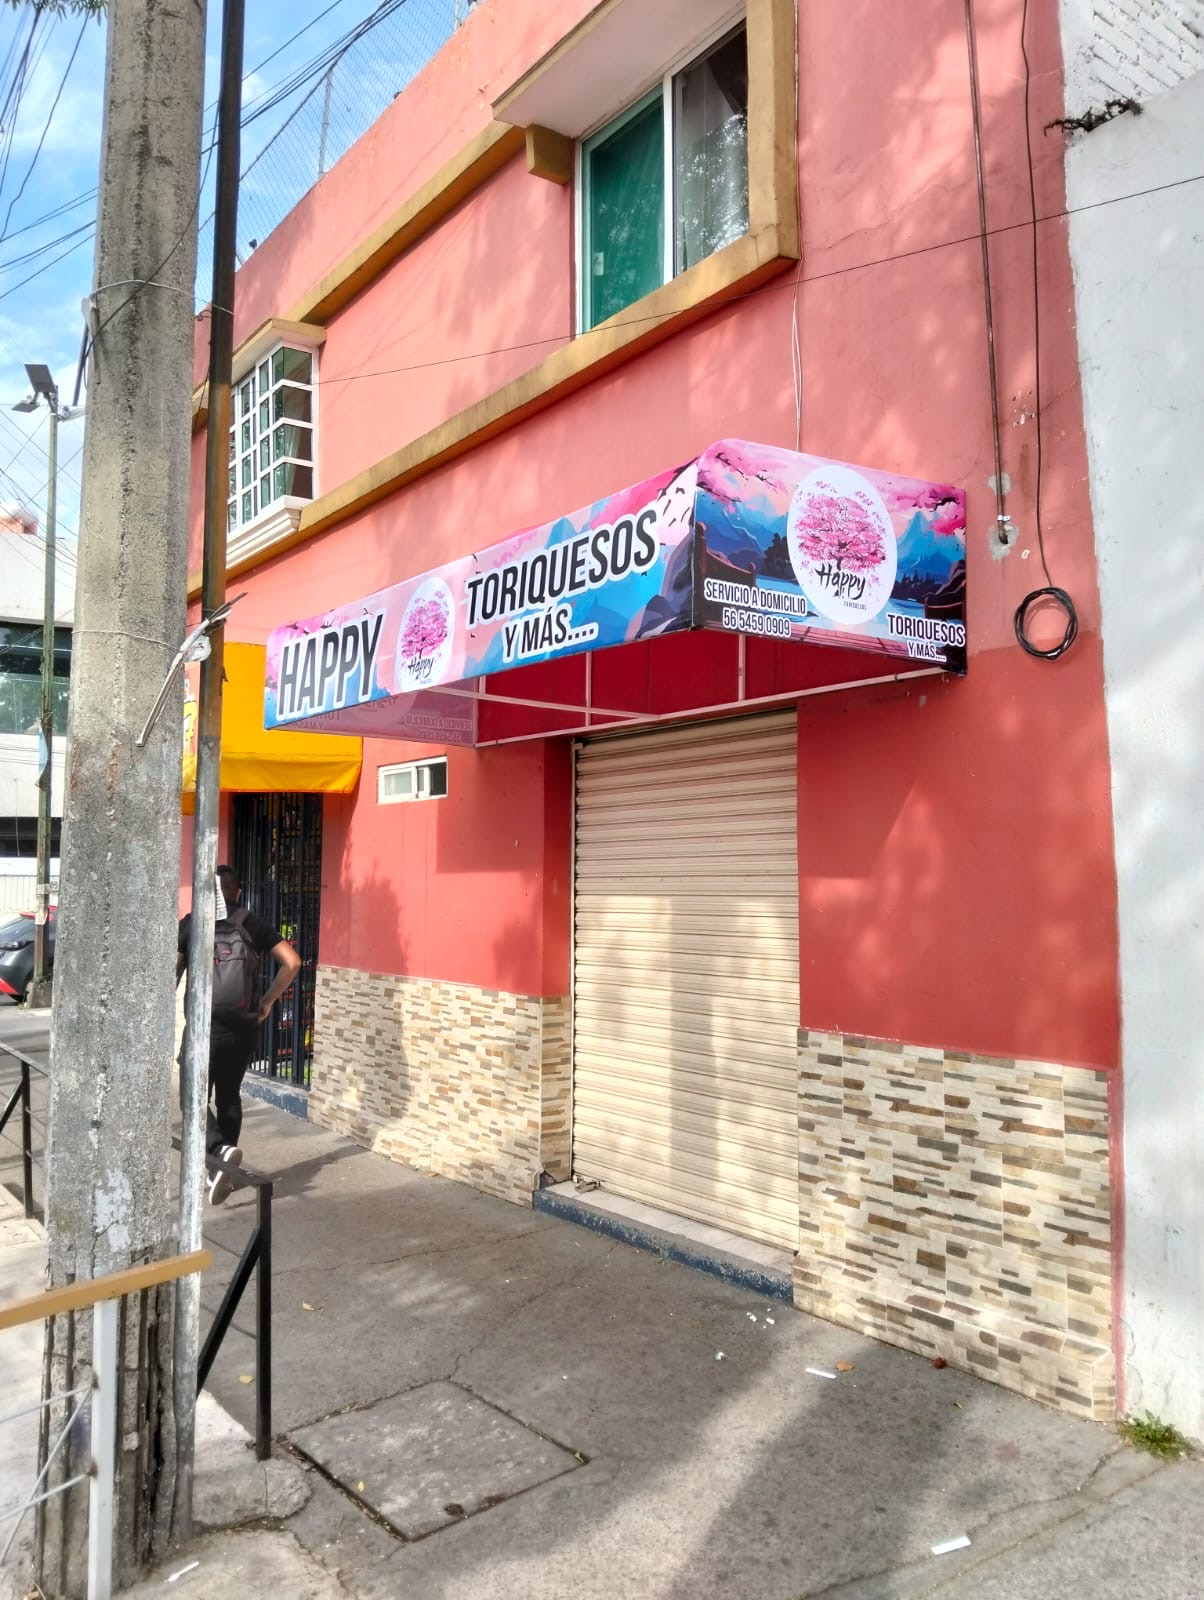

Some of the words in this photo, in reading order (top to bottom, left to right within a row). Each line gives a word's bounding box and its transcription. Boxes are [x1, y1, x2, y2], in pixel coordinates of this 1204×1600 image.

[466, 509, 658, 625] TORIQUESOS
[815, 562, 866, 600] Happy
[705, 580, 750, 605] SERVICIO
[751, 589, 759, 607] A
[760, 590, 807, 614] DOMICILIO
[723, 609, 737, 627] 56
[738, 612, 765, 633] 5459
[765, 617, 791, 637] 0909
[887, 613, 965, 645] TORIQUESOS
[505, 624, 518, 657] Y
[907, 641, 915, 656] Y
[277, 613, 385, 716] HAPPY
[407, 656, 435, 680] Happy
